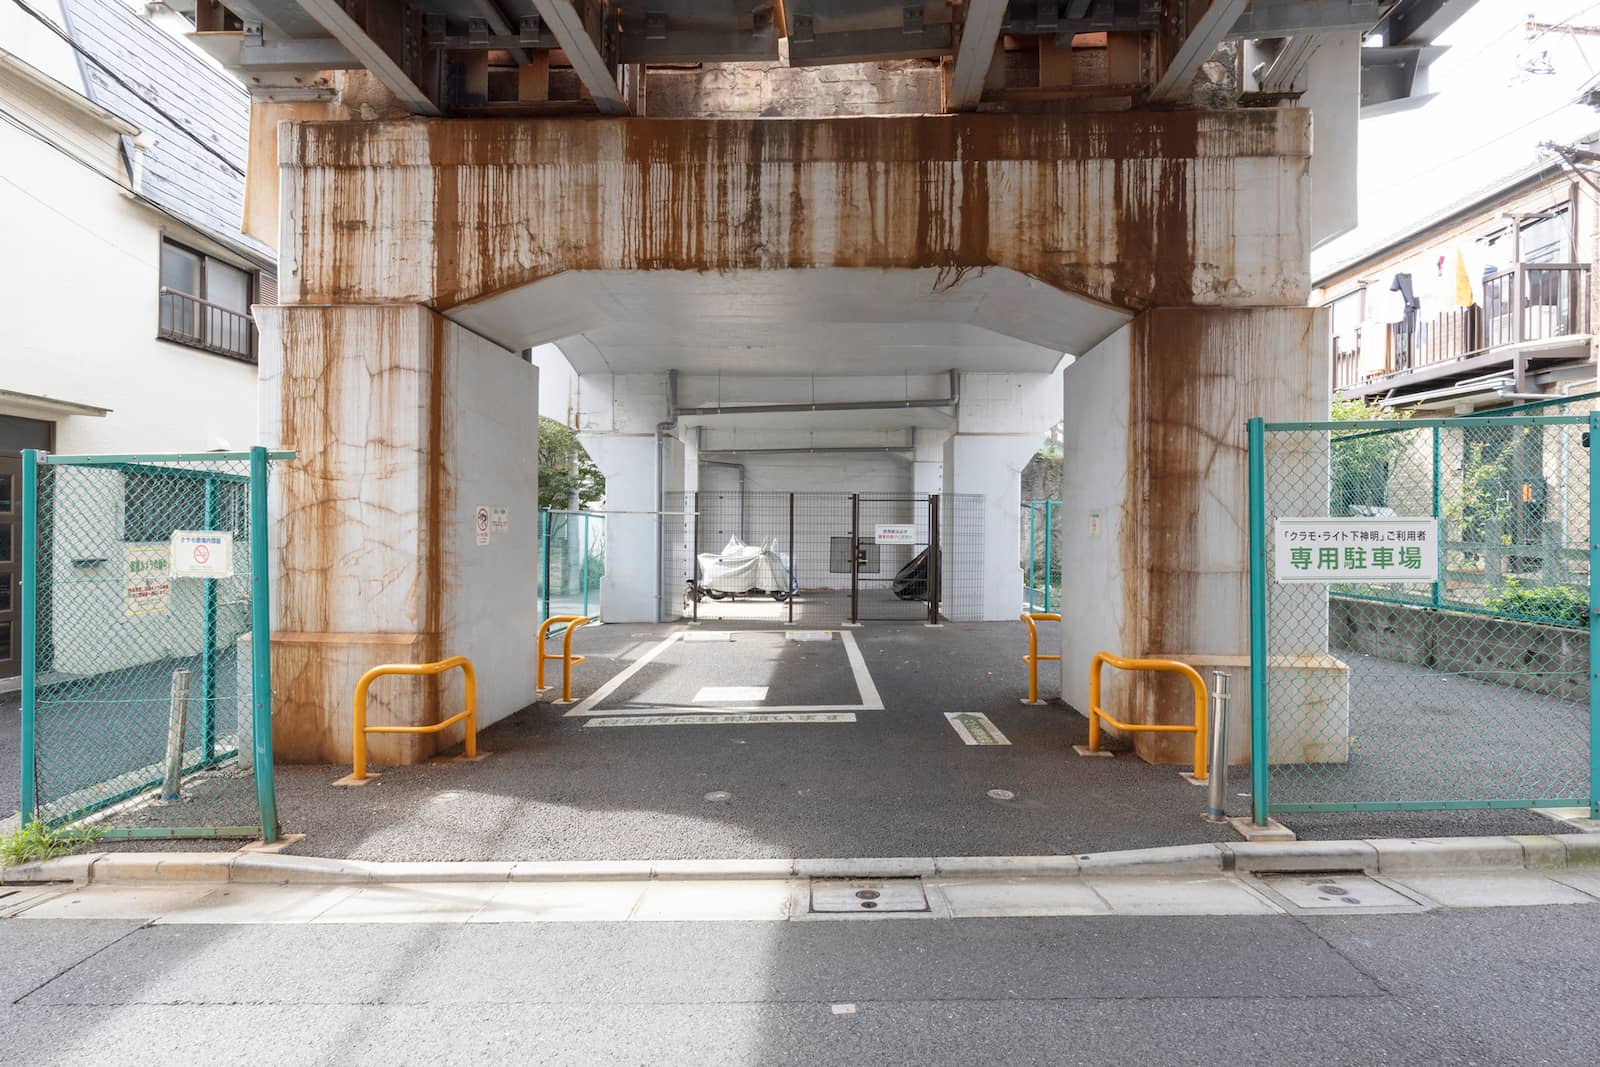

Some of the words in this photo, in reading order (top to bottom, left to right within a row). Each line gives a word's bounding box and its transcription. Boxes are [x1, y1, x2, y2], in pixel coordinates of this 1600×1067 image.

[1290, 546, 1422, 570] 専用駐車場
